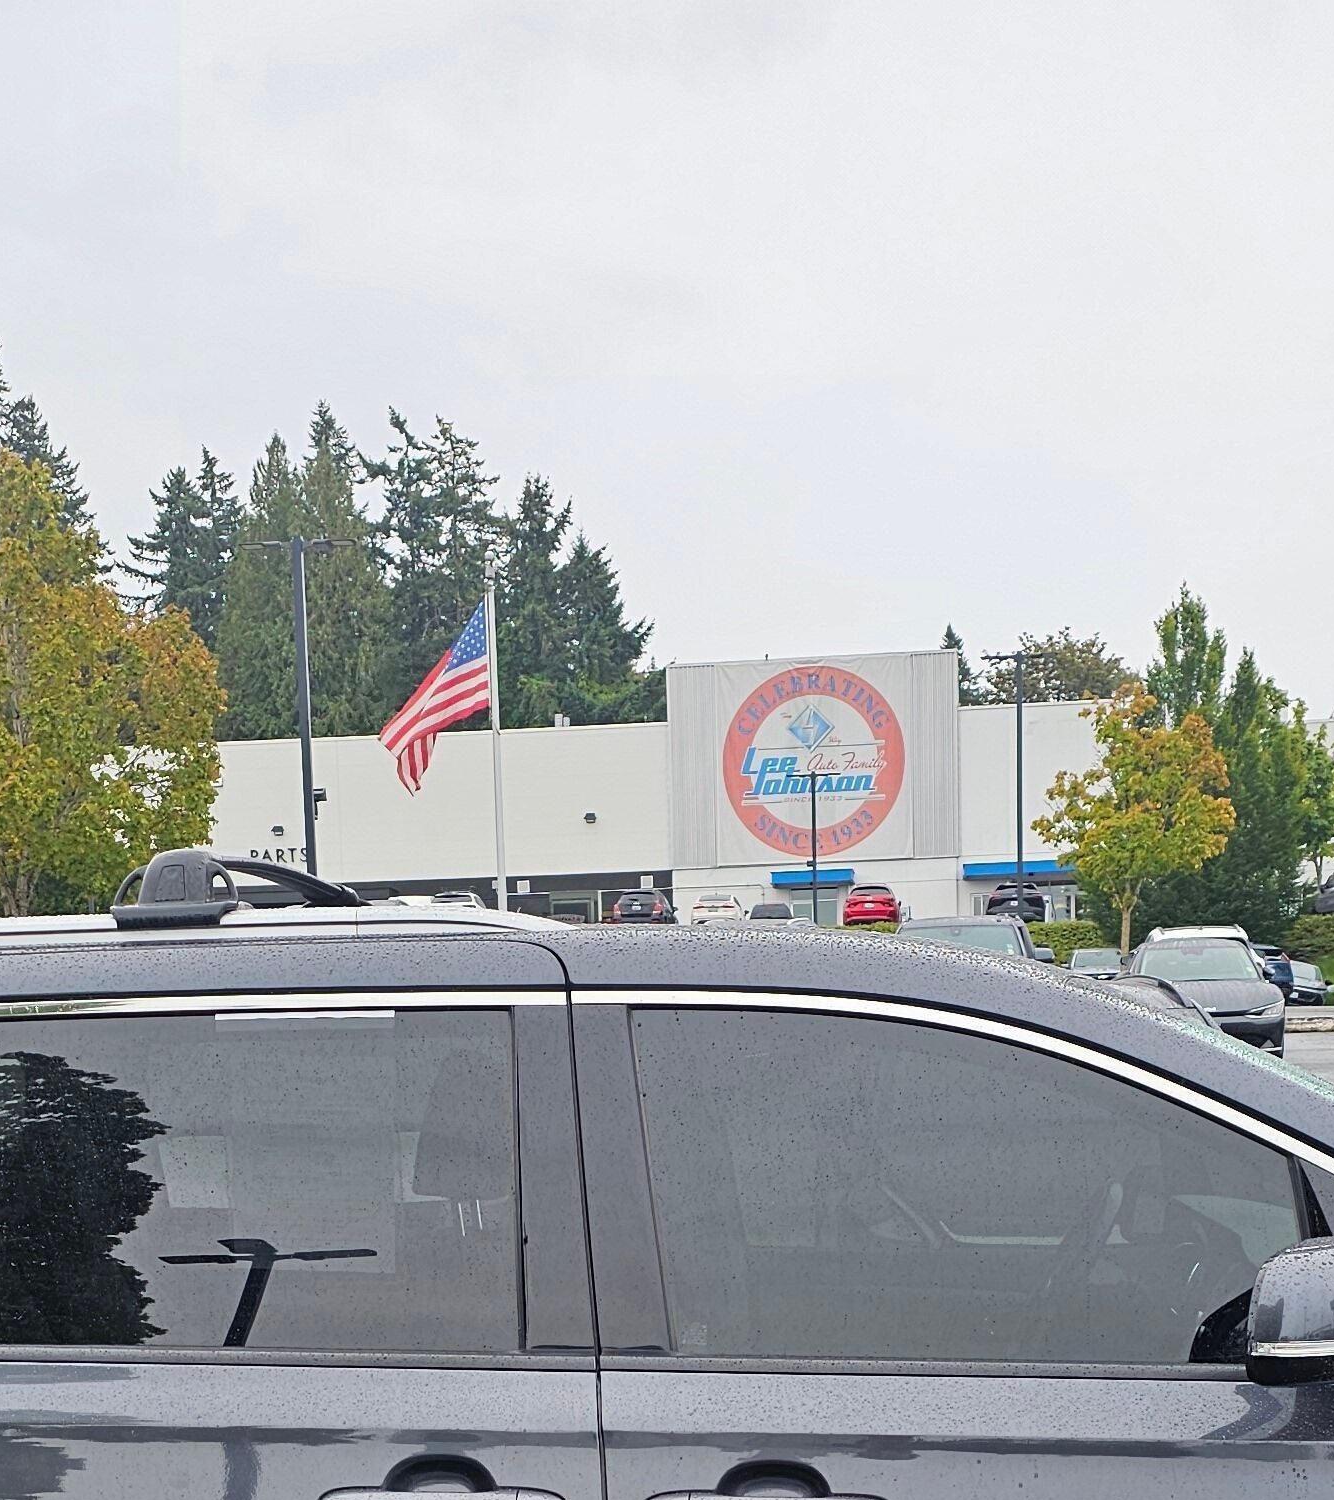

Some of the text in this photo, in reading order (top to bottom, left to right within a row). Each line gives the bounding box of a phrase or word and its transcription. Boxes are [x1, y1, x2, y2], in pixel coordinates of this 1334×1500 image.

[737, 673, 890, 736] CELEBRATING
[742, 747, 884, 774] Lee Auto Family
[745, 758, 876, 796] Johnson
[831, 809, 873, 845] 1933
